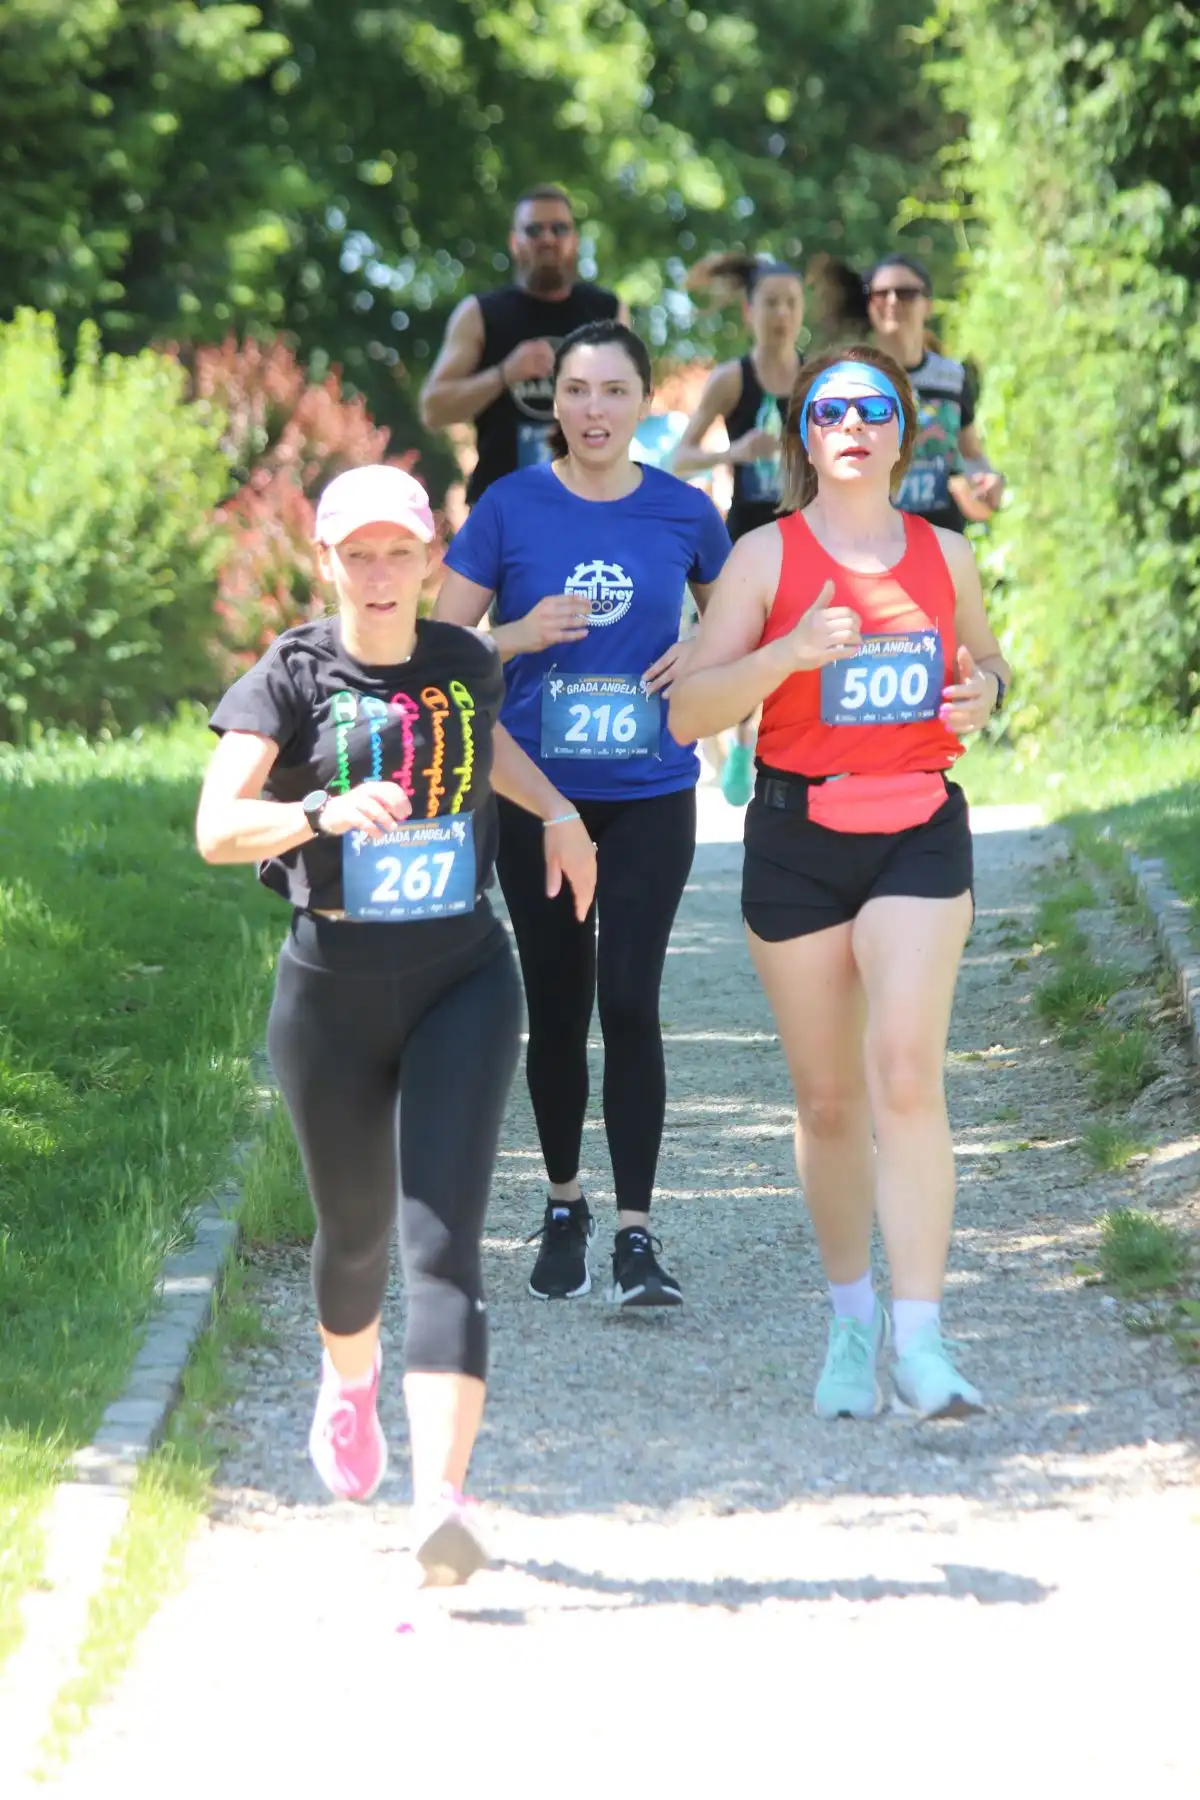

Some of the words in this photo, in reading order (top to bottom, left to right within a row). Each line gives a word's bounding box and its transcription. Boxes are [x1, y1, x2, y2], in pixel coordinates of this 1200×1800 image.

[601, 587, 633, 602] Frey
[566, 682, 598, 695] GRADA
[840, 663, 928, 709] 500
[331, 690, 357, 794] Champ
[565, 703, 637, 742] 216
[370, 850, 455, 902] 267
